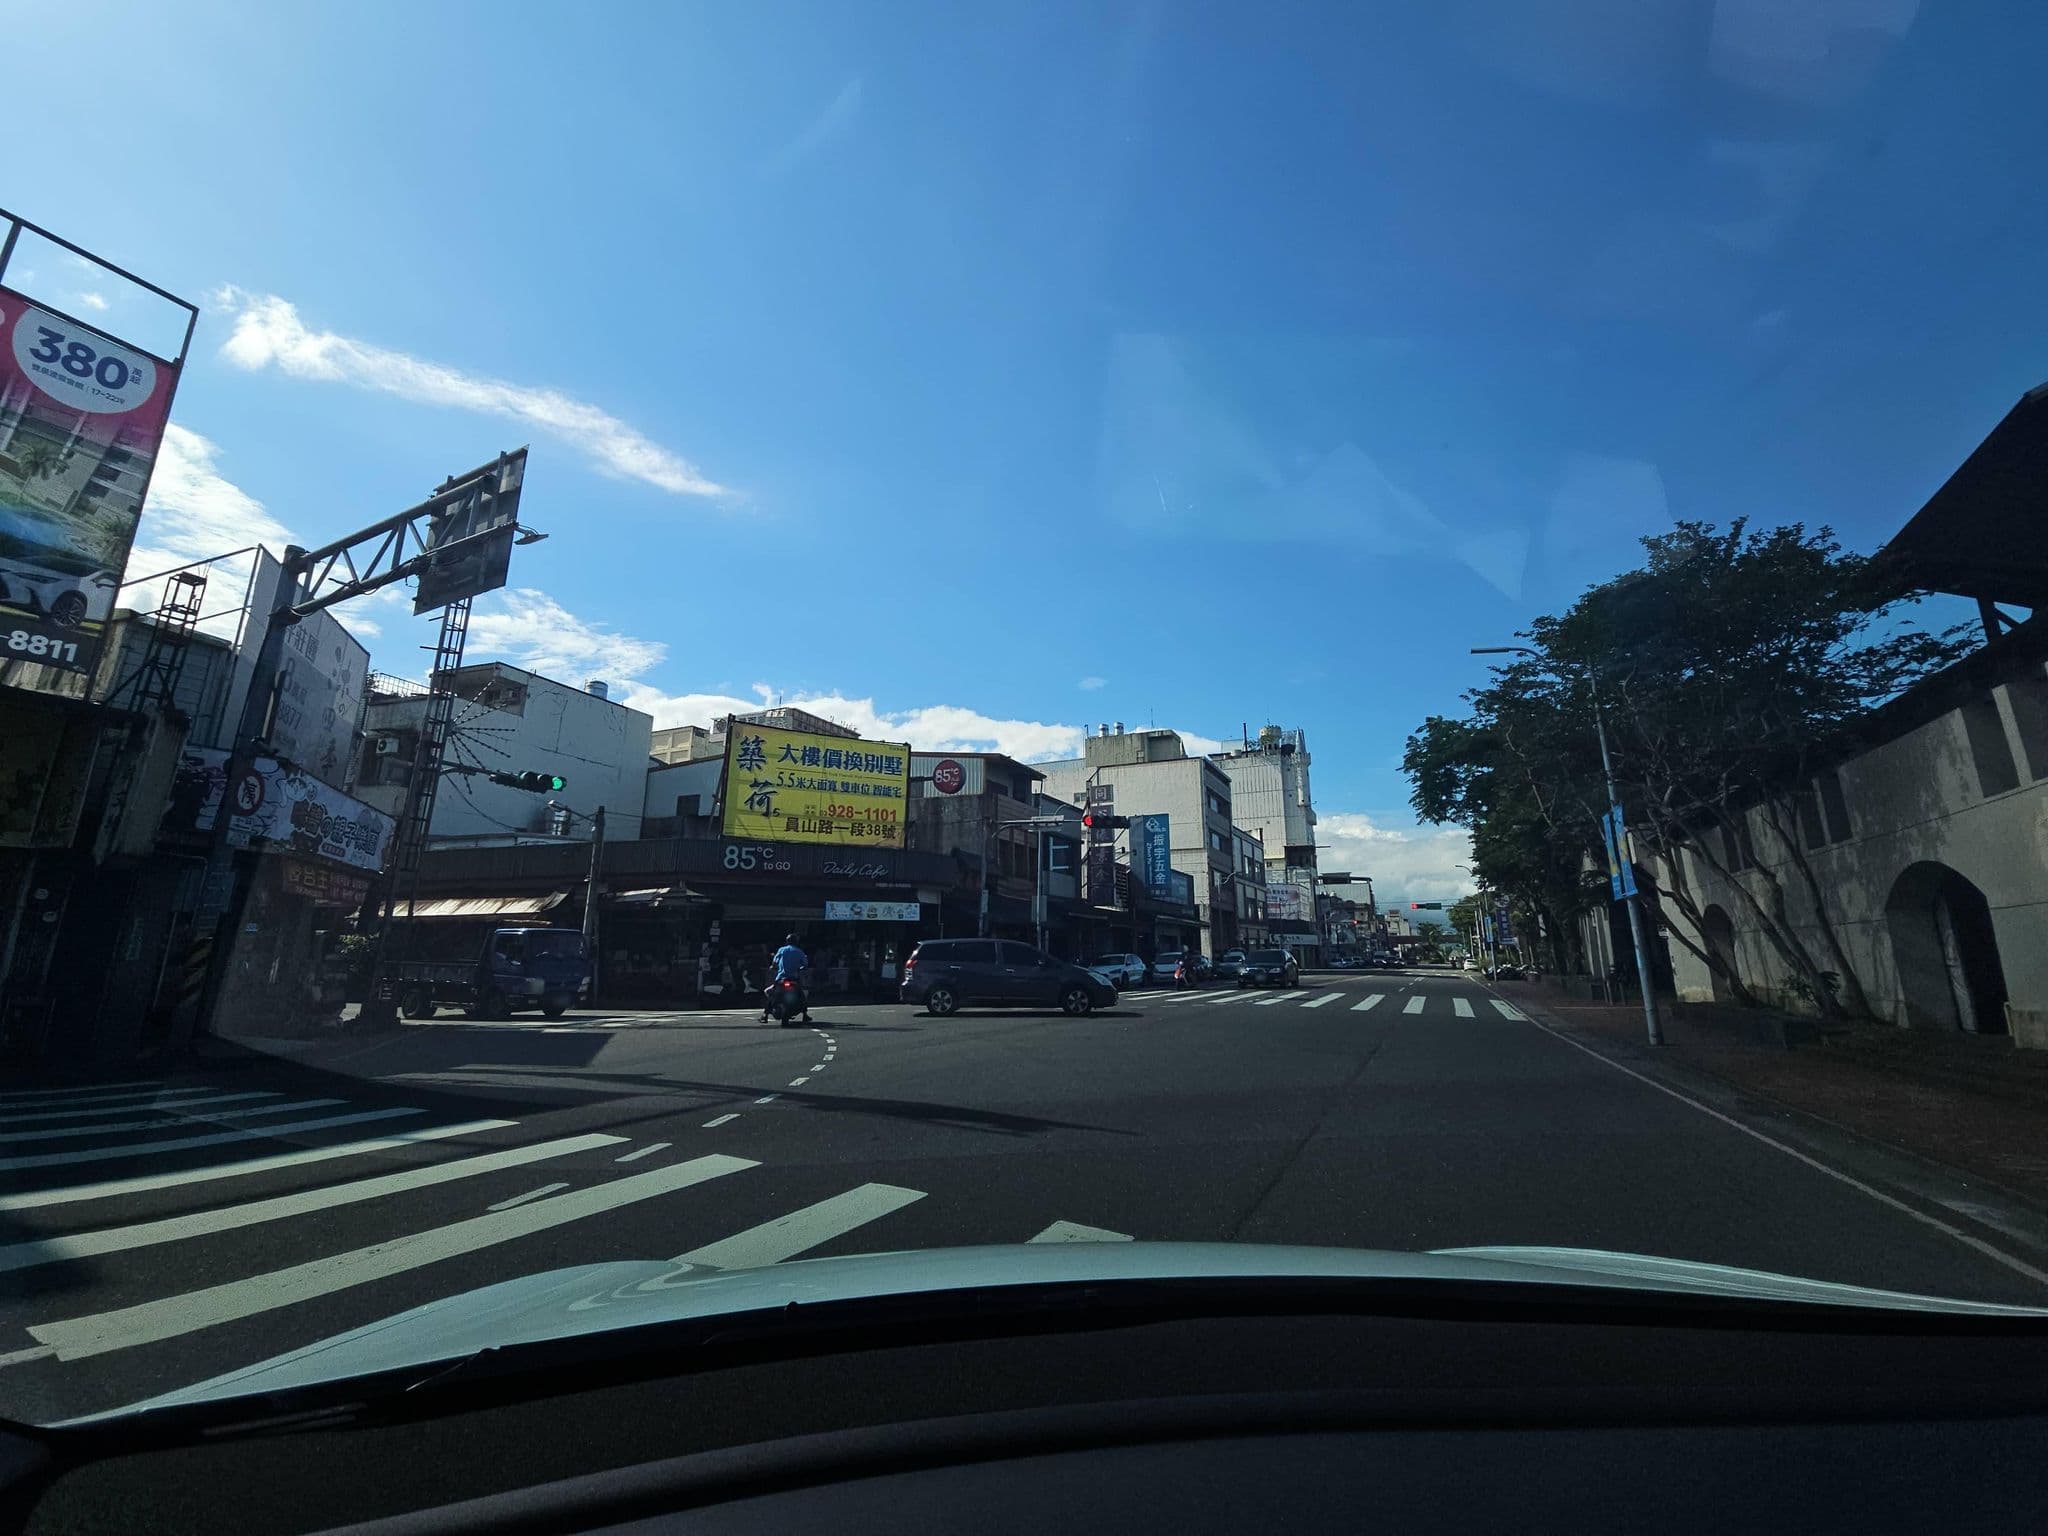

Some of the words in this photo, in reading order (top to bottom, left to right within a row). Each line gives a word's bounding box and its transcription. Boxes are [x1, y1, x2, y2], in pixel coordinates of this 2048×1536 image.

[29, 326, 129, 389] 380
[777, 743, 902, 776] 大樓價換別墅
[828, 804, 897, 822] 928-1101
[786, 817, 897, 839] 員山路一段38號
[764, 862, 774, 870] to
[775, 861, 791, 871] GO
[823, 862, 858, 878] Daily
[1153, 834, 1167, 885] 振宇五金
